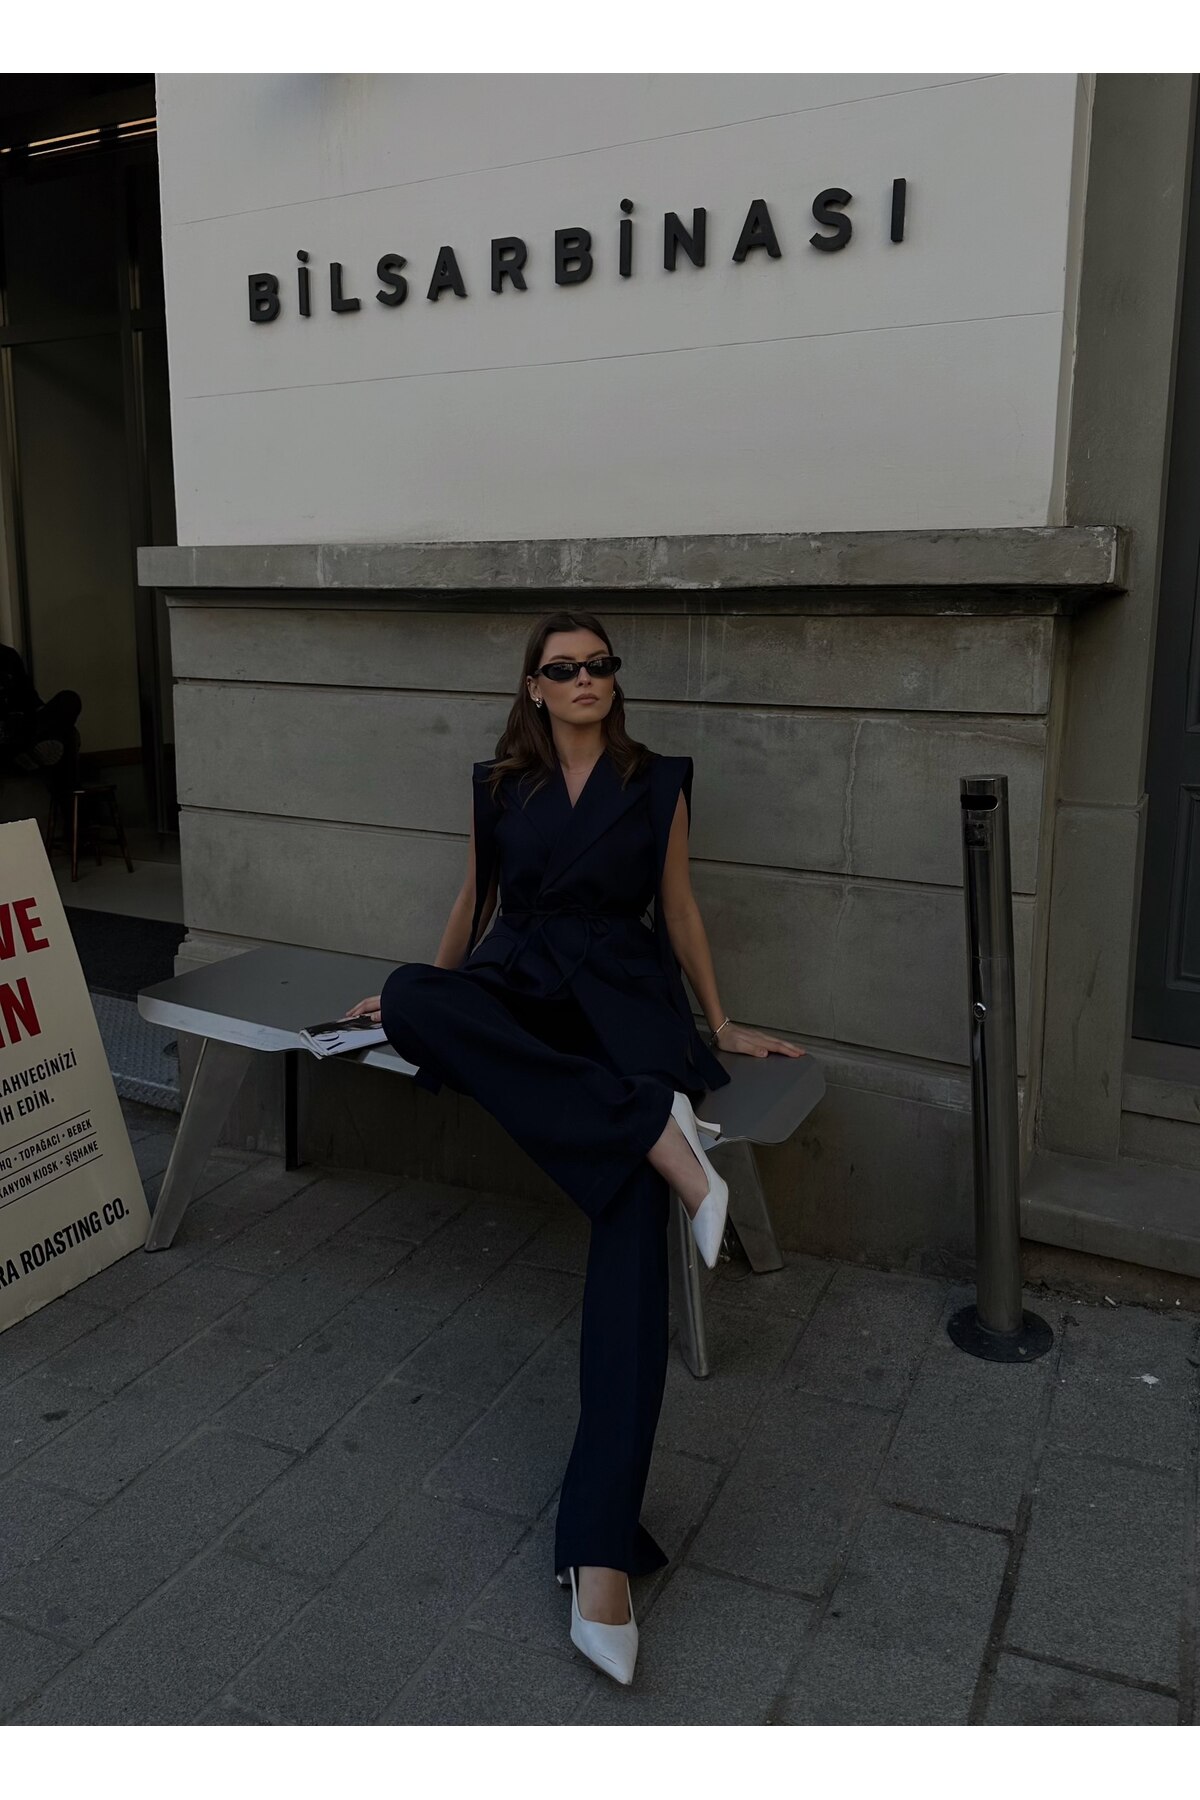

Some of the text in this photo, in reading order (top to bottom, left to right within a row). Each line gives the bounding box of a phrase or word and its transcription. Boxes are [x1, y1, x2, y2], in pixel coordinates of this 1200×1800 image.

[0, 977, 41, 1049] N
[0, 1048, 77, 1098] AHVECİNİZİ
[17, 1089, 55, 1117] EDİN.
[19, 1134, 61, 1161] TOPAĞACI
[67, 1118, 92, 1138] BEBEK
[33, 1161, 59, 1181] KIOSK
[64, 1140, 99, 1167] ŞİŞHANE
[20, 1211, 102, 1275] ROASTING
[102, 1198, 130, 1226] CO.
